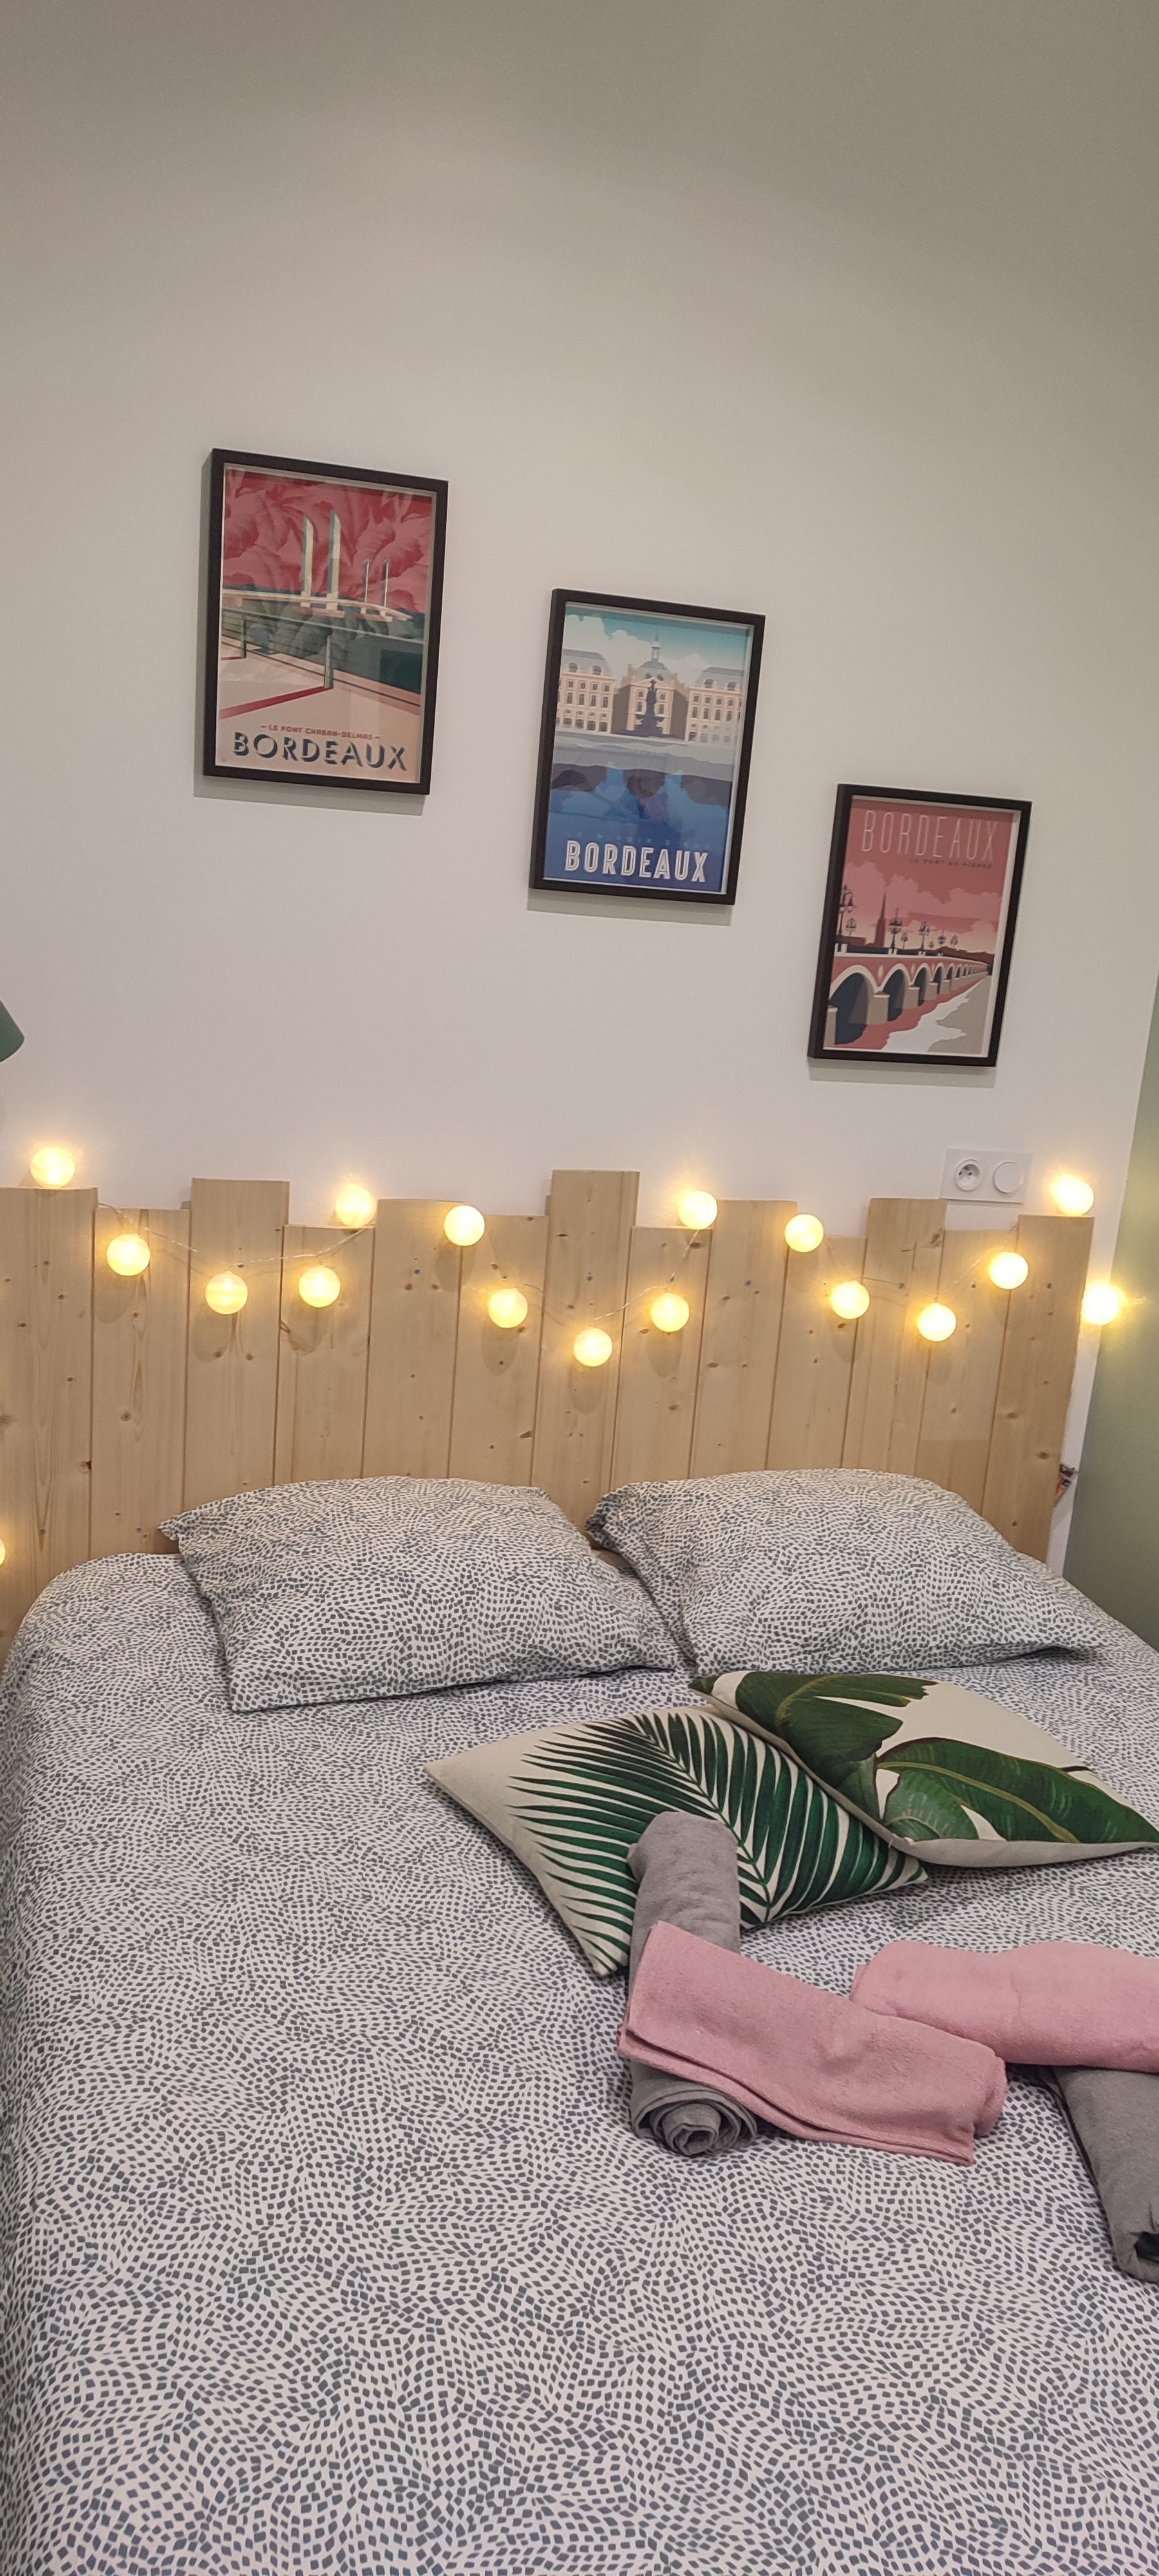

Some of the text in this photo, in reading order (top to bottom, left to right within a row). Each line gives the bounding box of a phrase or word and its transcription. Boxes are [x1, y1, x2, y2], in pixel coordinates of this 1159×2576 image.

[232, 732, 407, 771] BORDEAUX
[862, 810, 998, 861] BORDEAUX
[565, 840, 709, 883] BORDEAUX
